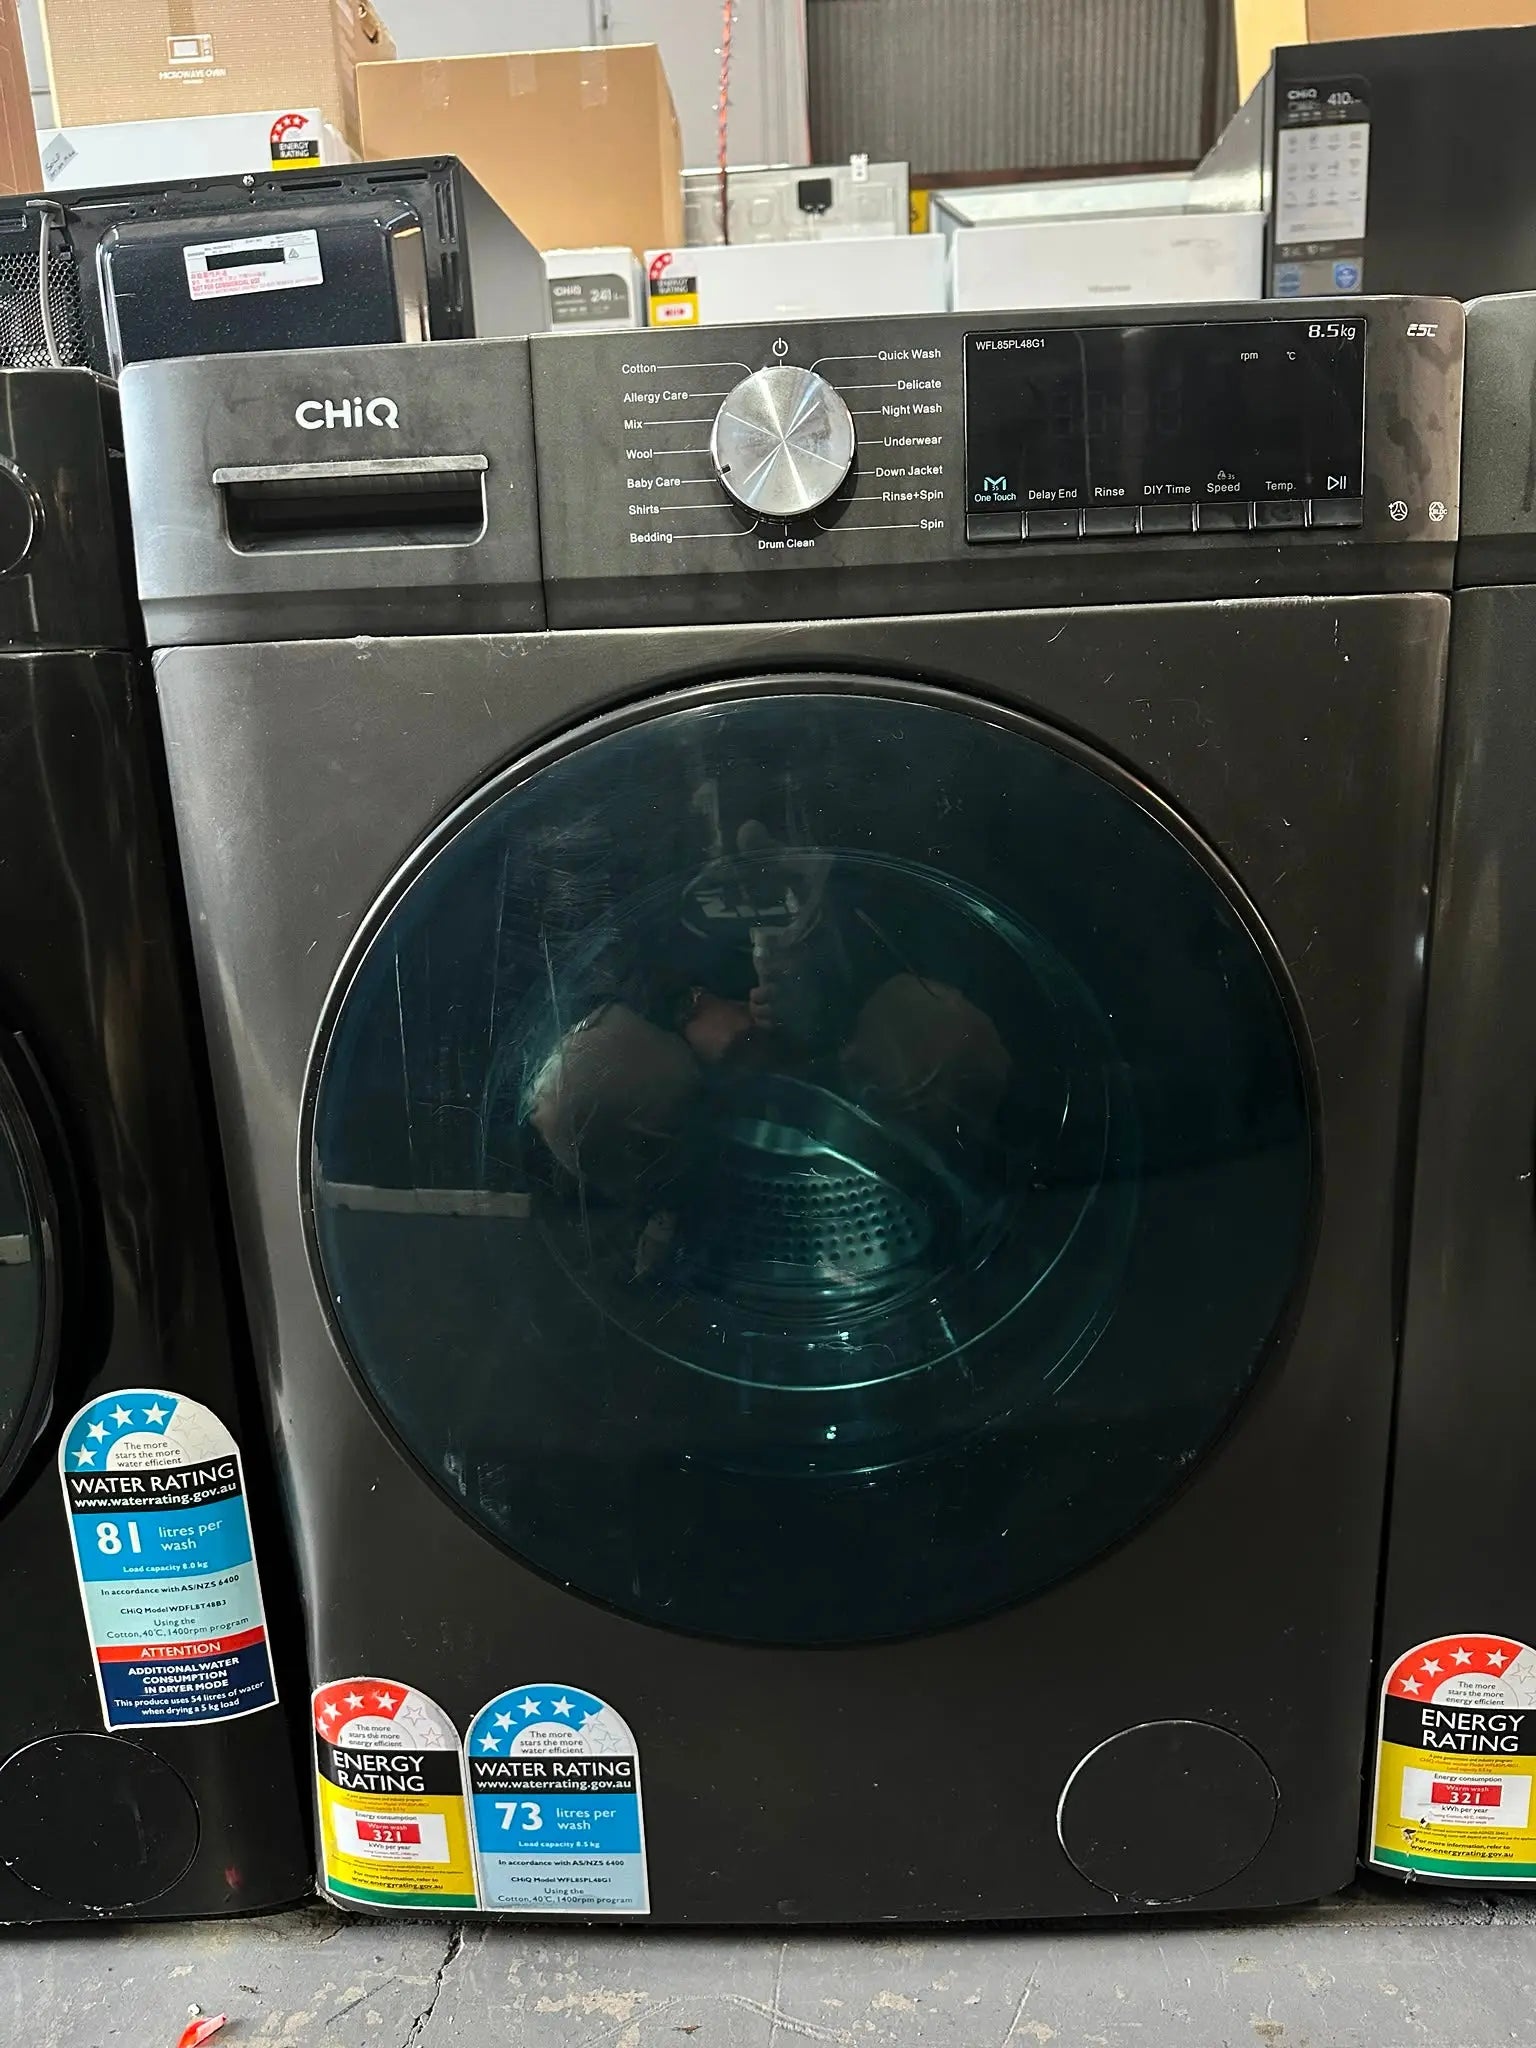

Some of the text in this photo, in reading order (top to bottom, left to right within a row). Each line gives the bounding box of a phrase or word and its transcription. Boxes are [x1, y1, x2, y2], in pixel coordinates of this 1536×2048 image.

[279, 142, 309, 150] ENERGY
[1308, 324, 1356, 340] 8.5kg
[976, 339, 1045, 350] WFL85PL48G1
[878, 348, 941, 361] Quick Wash
[1240, 352, 1258, 360] rpm
[622, 363, 656, 374] Cotton
[897, 379, 942, 390] Delicate
[624, 390, 688, 404] Allergy Care
[295, 397, 399, 430] CHiQ
[882, 403, 942, 416] Night Wash
[624, 419, 643, 429] Mix
[884, 435, 943, 447] Underwear
[626, 449, 653, 459] Wool
[875, 465, 943, 477] Down Jacket
[627, 476, 681, 489] Baby Care
[1207, 483, 1240, 493] Speed
[1265, 481, 1296, 491] Temp.
[882, 489, 944, 502] Rinse+Spin
[1029, 489, 1077, 500] Delay End
[1095, 487, 1125, 496] Rinse
[1144, 485, 1191, 495] DIY Time
[974, 492, 1016, 502] One Touch
[629, 504, 660, 515] Shirts
[920, 519, 944, 531] Spin
[630, 532, 673, 544] Bedding
[758, 538, 815, 549] Drum Clean
[115, 1451, 137, 1459] stars
[155, 1449, 180, 1457] more
[117, 1457, 182, 1468] water efficient
[71, 1463, 234, 1494] WATER RATING
[75, 1482, 236, 1508] www.waterrating.gov.au
[159, 1520, 223, 1538] litres per
[96, 1521, 142, 1554] 81
[161, 1539, 197, 1551] wash
[146, 1564, 180, 1574] capacity
[197, 1560, 208, 1569] kg
[111, 1587, 159, 1596] accordance
[161, 1585, 180, 1593] with
[181, 1580, 216, 1593] AS/NZS
[218, 1574, 239, 1586] 6400
[120, 1607, 143, 1615] CHiQ
[145, 1606, 168, 1614] Model
[154, 1617, 195, 1627] Using the
[210, 1617, 249, 1633] program
[141, 1642, 221, 1658] ATTENTION
[128, 1657, 239, 1676] ADDITIONAL WATER
[143, 1670, 227, 1685] CONSUMPTION
[159, 1684, 194, 1693] DRYER
[195, 1679, 229, 1691] MODE
[1458, 1681, 1473, 1689] The
[114, 1699, 132, 1707] This
[134, 1698, 169, 1707] produce
[203, 1693, 226, 1702] litres
[228, 1689, 237, 1697] of
[239, 1681, 264, 1694] water
[142, 1708, 164, 1716] when
[166, 1706, 193, 1716] drying
[208, 1703, 219, 1711] kg
[221, 1699, 239, 1708] load
[1446, 1698, 1504, 1706] energy efficient
[1422, 1708, 1525, 1732] ENERGY
[1423, 1730, 1518, 1752] RATING
[333, 1750, 424, 1772] ENERGY
[474, 1762, 631, 1777] WATER RATING
[337, 1770, 424, 1791] RATING
[477, 1779, 631, 1791] www.waterrating.gov.au
[1450, 1793, 1480, 1805] 321
[495, 1802, 543, 1831] 73
[556, 1808, 616, 1820] litres per
[557, 1820, 591, 1830] wash
[373, 1830, 402, 1841] 321
